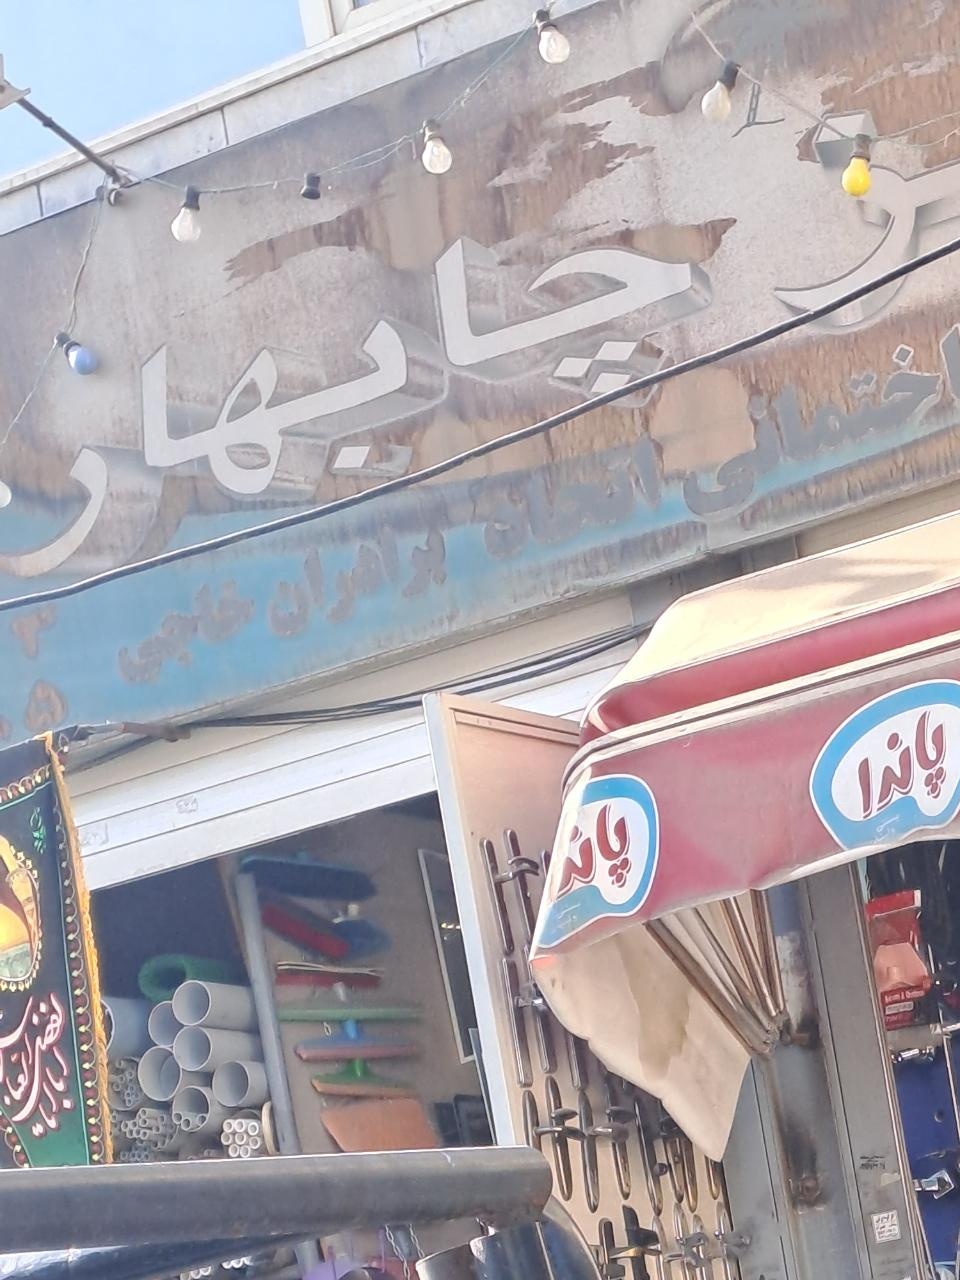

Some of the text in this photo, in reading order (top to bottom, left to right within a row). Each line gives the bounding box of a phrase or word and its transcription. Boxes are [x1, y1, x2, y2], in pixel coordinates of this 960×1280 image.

[0, 238, 698, 580] چابهار
[268, 526, 447, 637] برادران
[857, 709, 947, 820] پاندا
